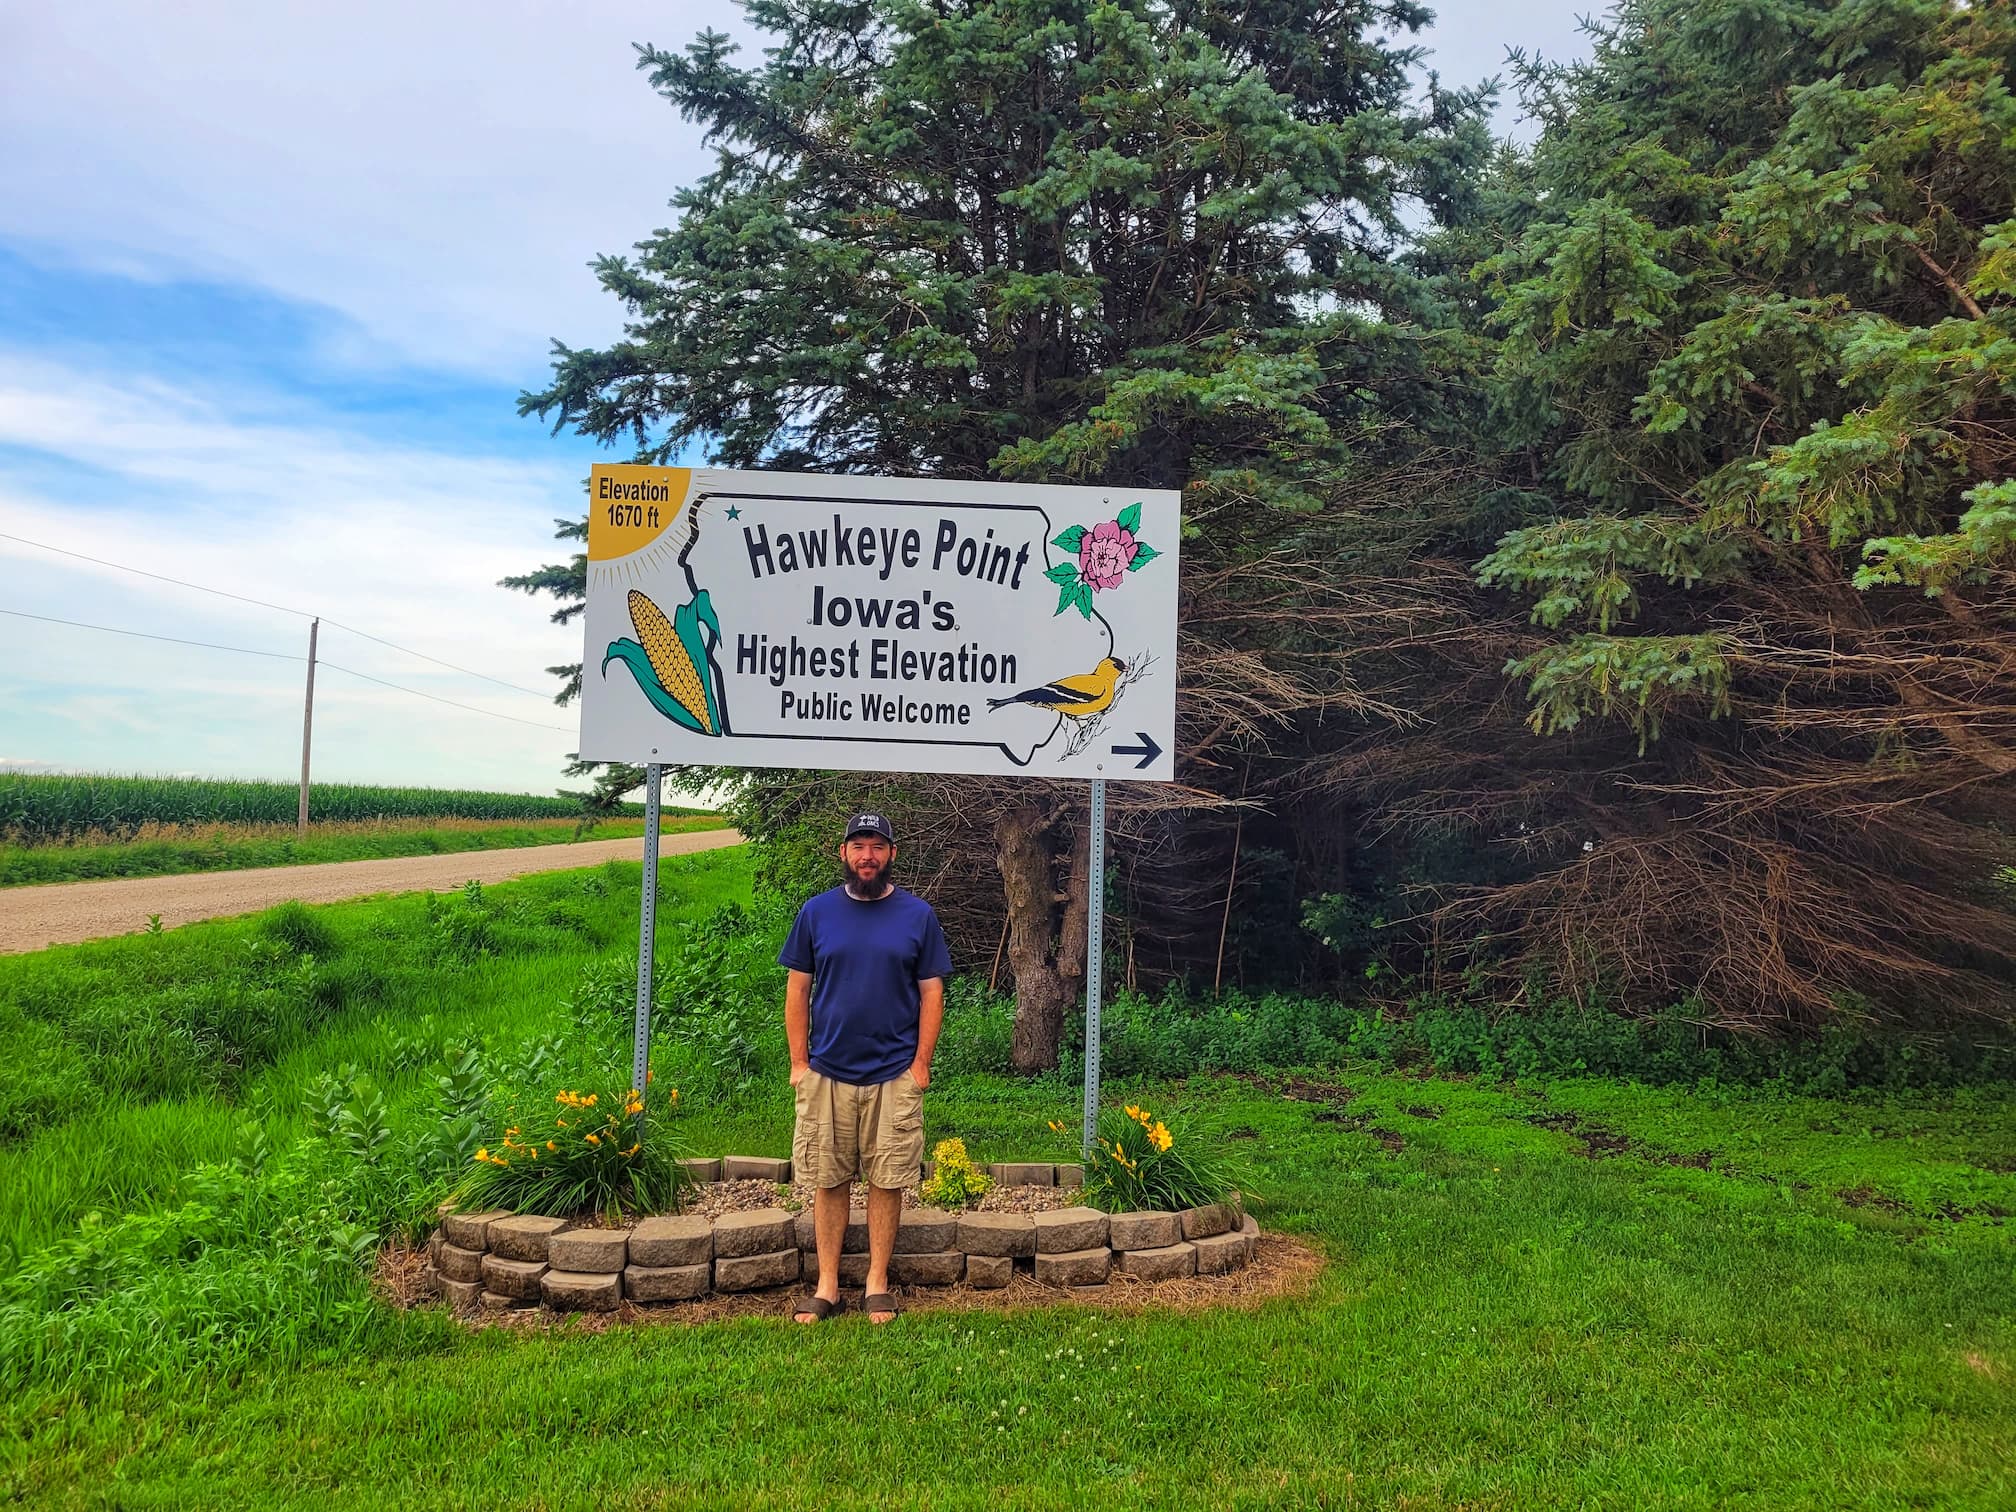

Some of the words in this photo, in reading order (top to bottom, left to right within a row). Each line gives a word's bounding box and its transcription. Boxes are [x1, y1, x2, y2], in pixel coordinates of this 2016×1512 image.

[600, 477, 669, 502] Elevation
[608, 504, 642, 527] 1670
[648, 506, 659, 529] ft
[743, 514, 920, 581] Hawkeye
[933, 519, 1031, 591] Point
[813, 585, 955, 632] Iowa's
[736, 633, 859, 687] Highest
[870, 639, 1017, 684] Elevation
[780, 690, 852, 722] Public
[861, 694, 971, 725] Welcome
